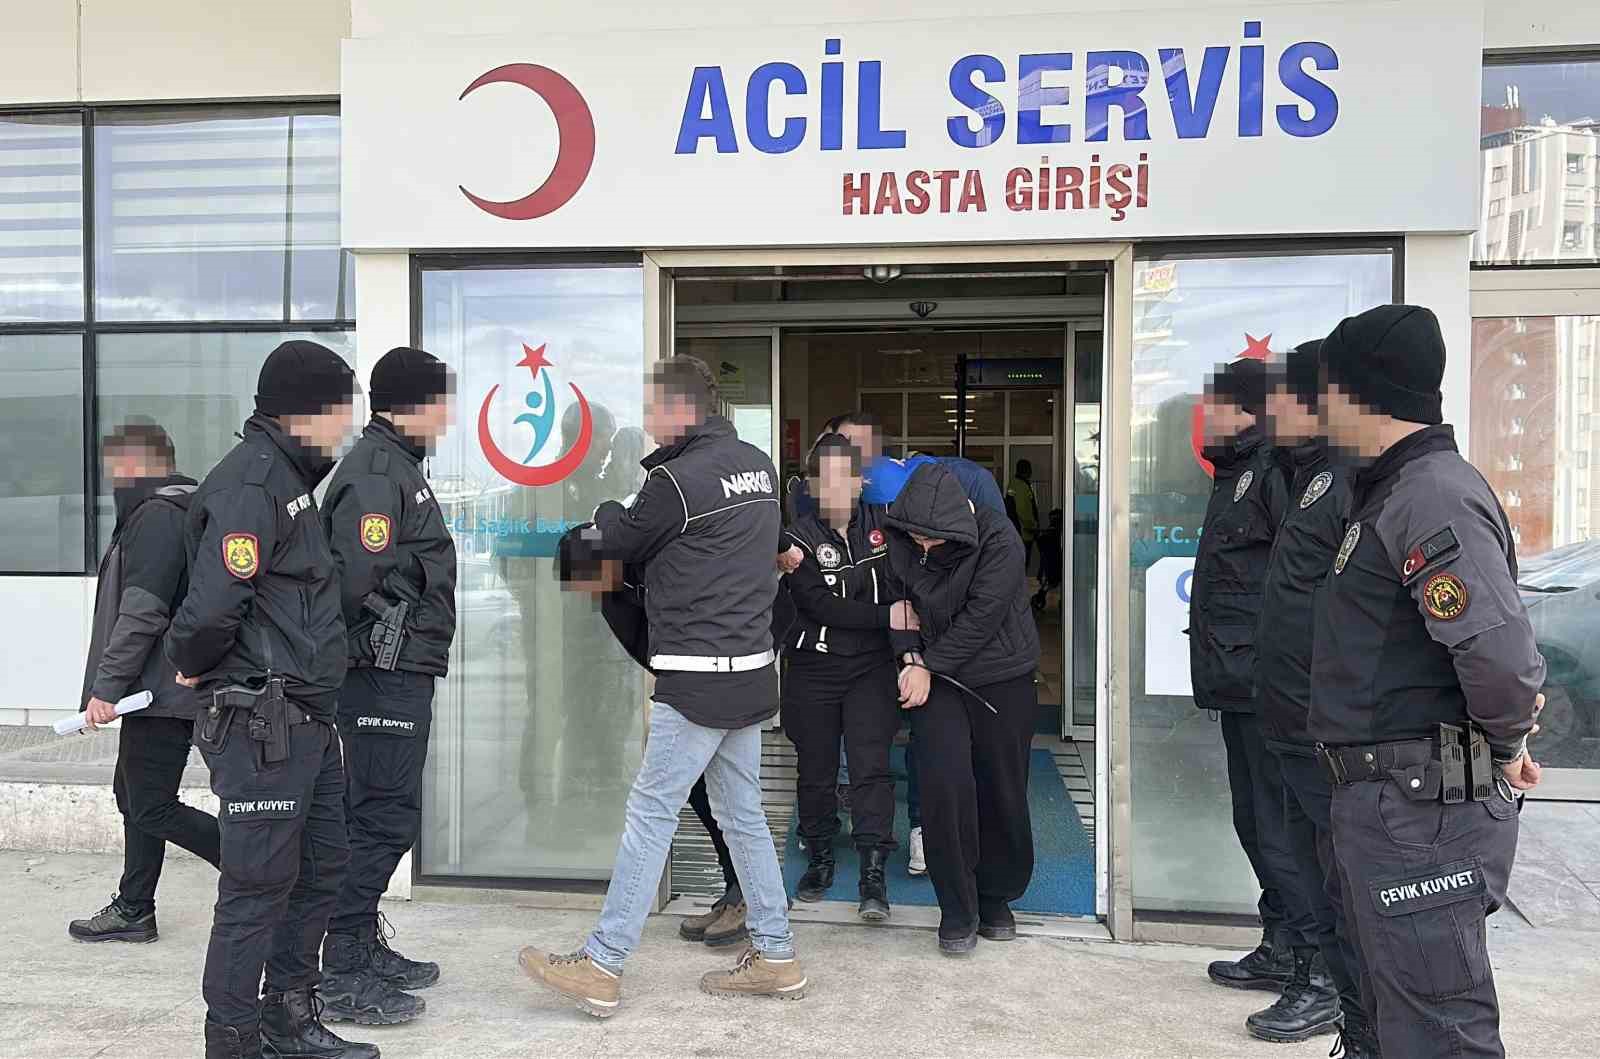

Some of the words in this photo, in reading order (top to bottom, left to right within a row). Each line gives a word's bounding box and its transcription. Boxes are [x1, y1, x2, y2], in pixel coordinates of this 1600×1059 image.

[675, 38, 906, 154] ACİL
[946, 21, 1339, 147] SERVİS
[841, 168, 987, 216] HASTA
[1004, 152, 1150, 221] GİRİŞİ
[1153, 525, 1190, 544] T.C.
[382, 718, 415, 731] KUVVET
[257, 800, 297, 812] KUVVET
[1420, 870, 1474, 896] KUVVET
